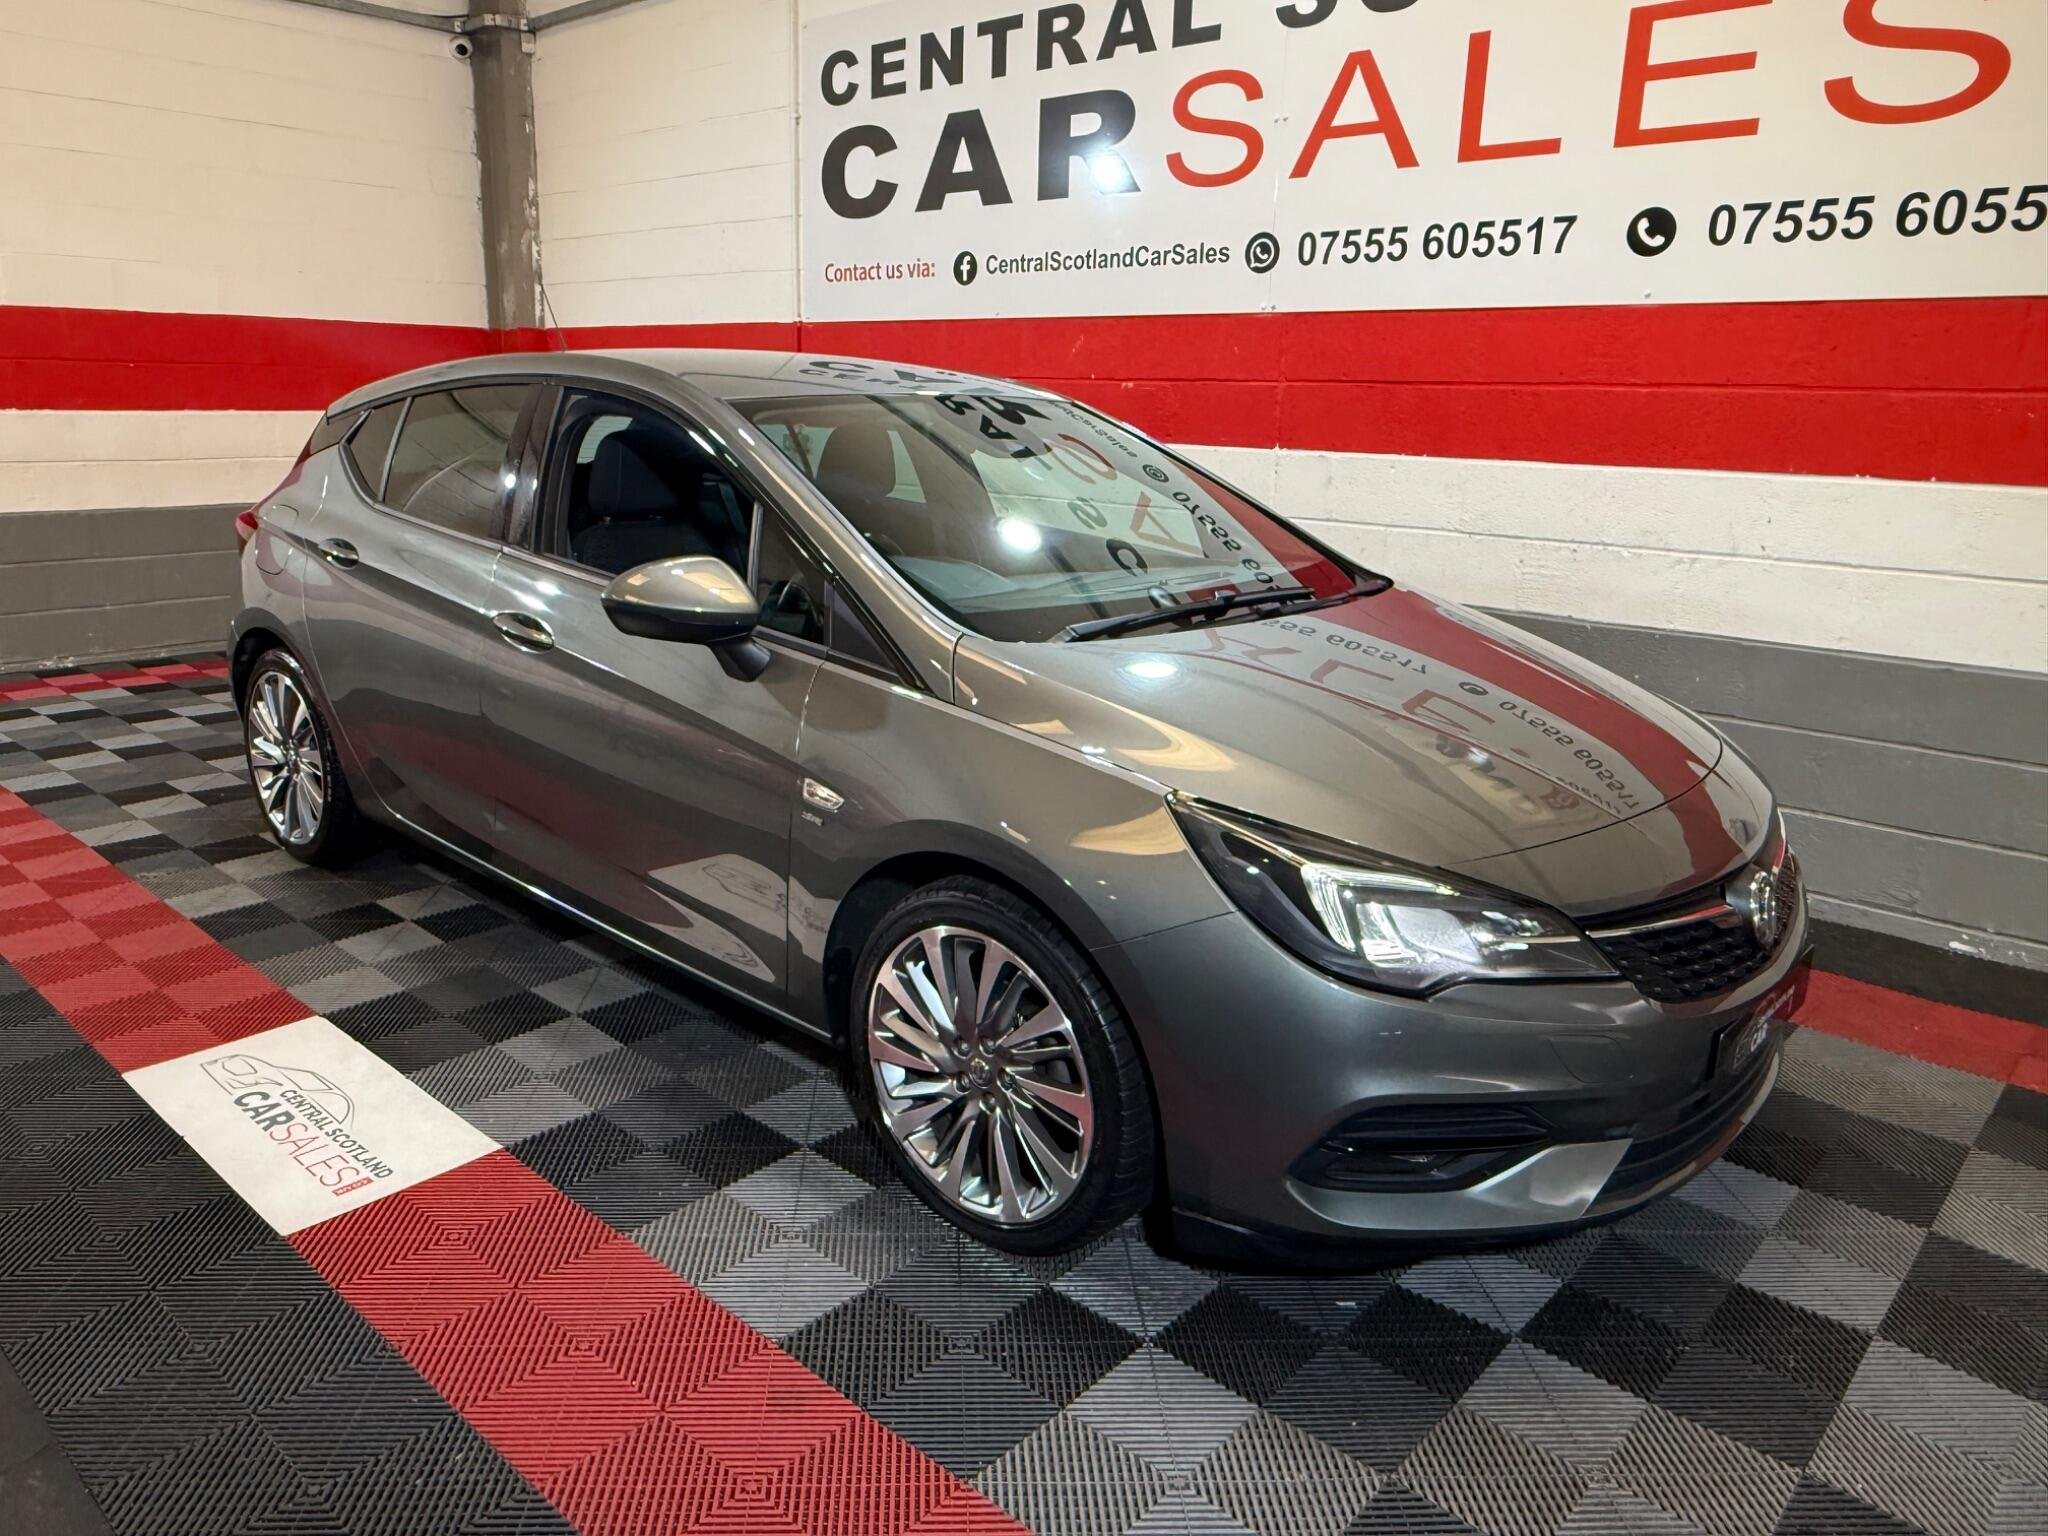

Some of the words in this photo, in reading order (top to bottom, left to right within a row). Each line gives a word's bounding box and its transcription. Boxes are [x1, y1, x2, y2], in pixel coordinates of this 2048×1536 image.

[820, 0, 1222, 107] CENTRAL
[824, 262, 882, 282] Contact
[886, 263, 904, 279] us
[907, 257, 936, 278] via:
[985, 242, 1231, 275] CentralScotlandCarSales
[1297, 225, 1409, 267] 07555
[1422, 214, 1578, 260] 605517
[1708, 195, 1876, 247] 07555
[1895, 184, 2048, 238] 6055
[279, 1089, 334, 1132] CENTRAL
[324, 1127, 394, 1179] SCOTLAND
